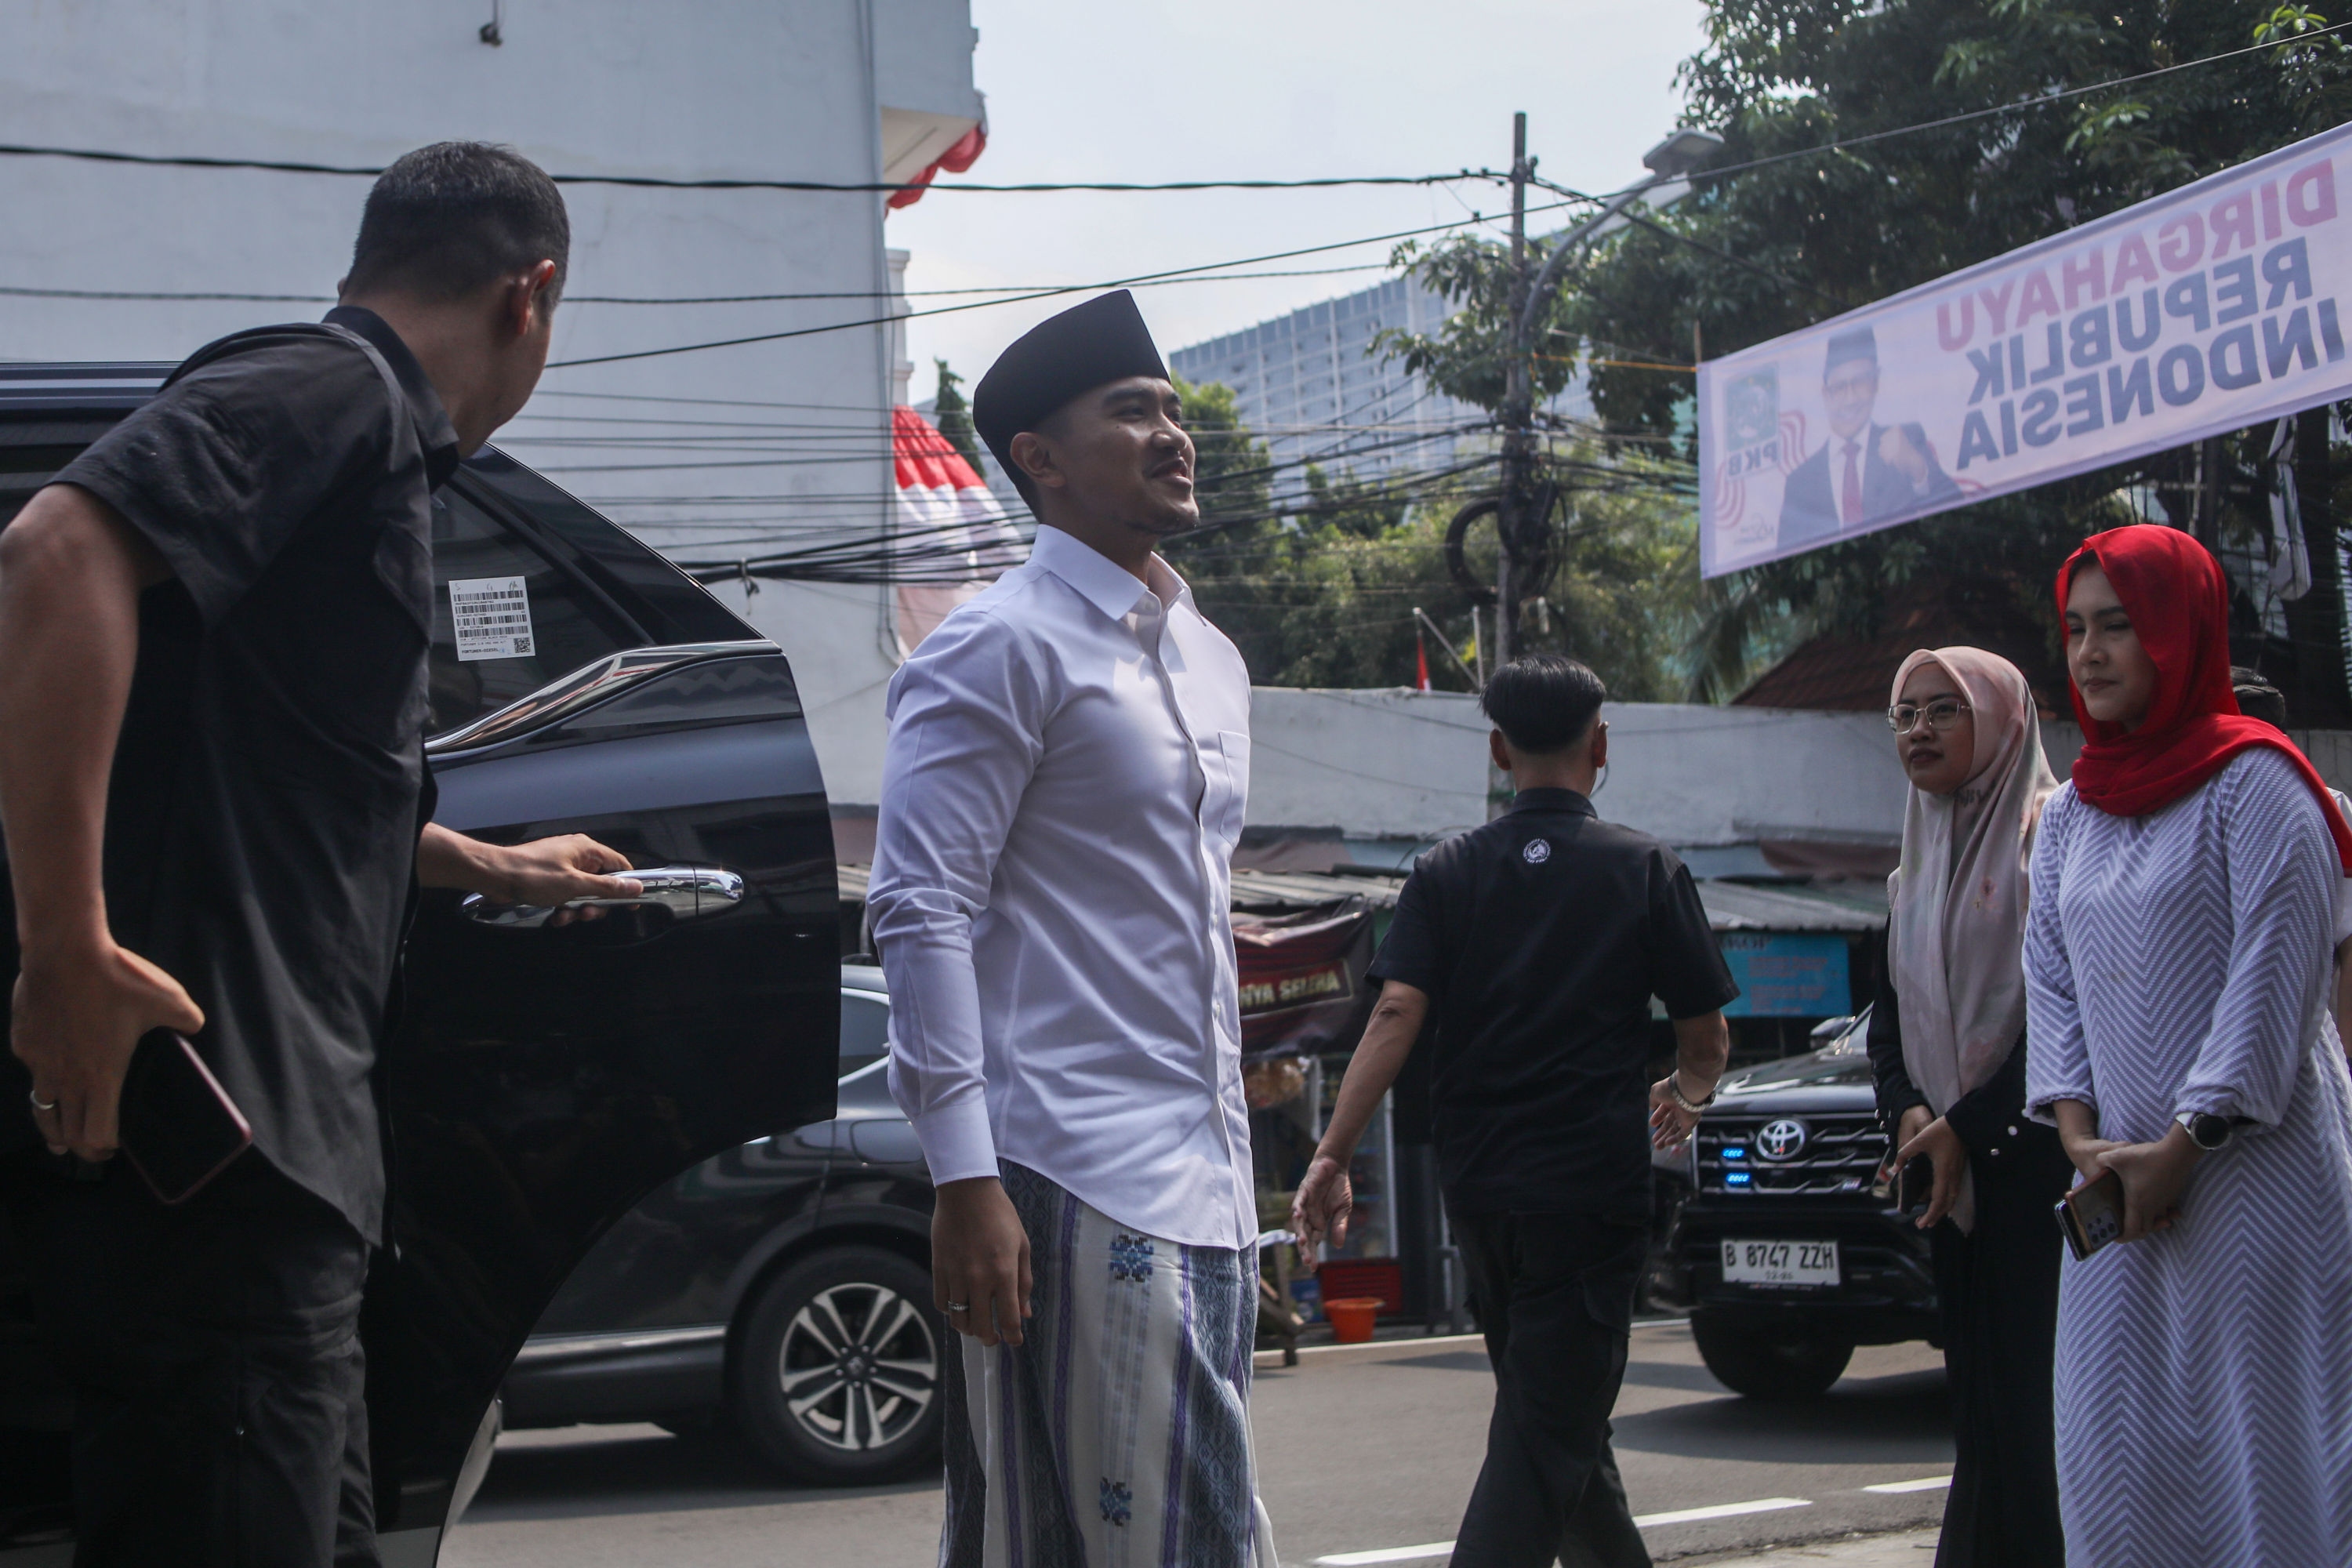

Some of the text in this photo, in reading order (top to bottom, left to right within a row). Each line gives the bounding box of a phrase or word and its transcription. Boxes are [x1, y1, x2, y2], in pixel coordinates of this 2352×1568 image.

[1726, 1243, 1835, 1269] B 8747 ZZH
